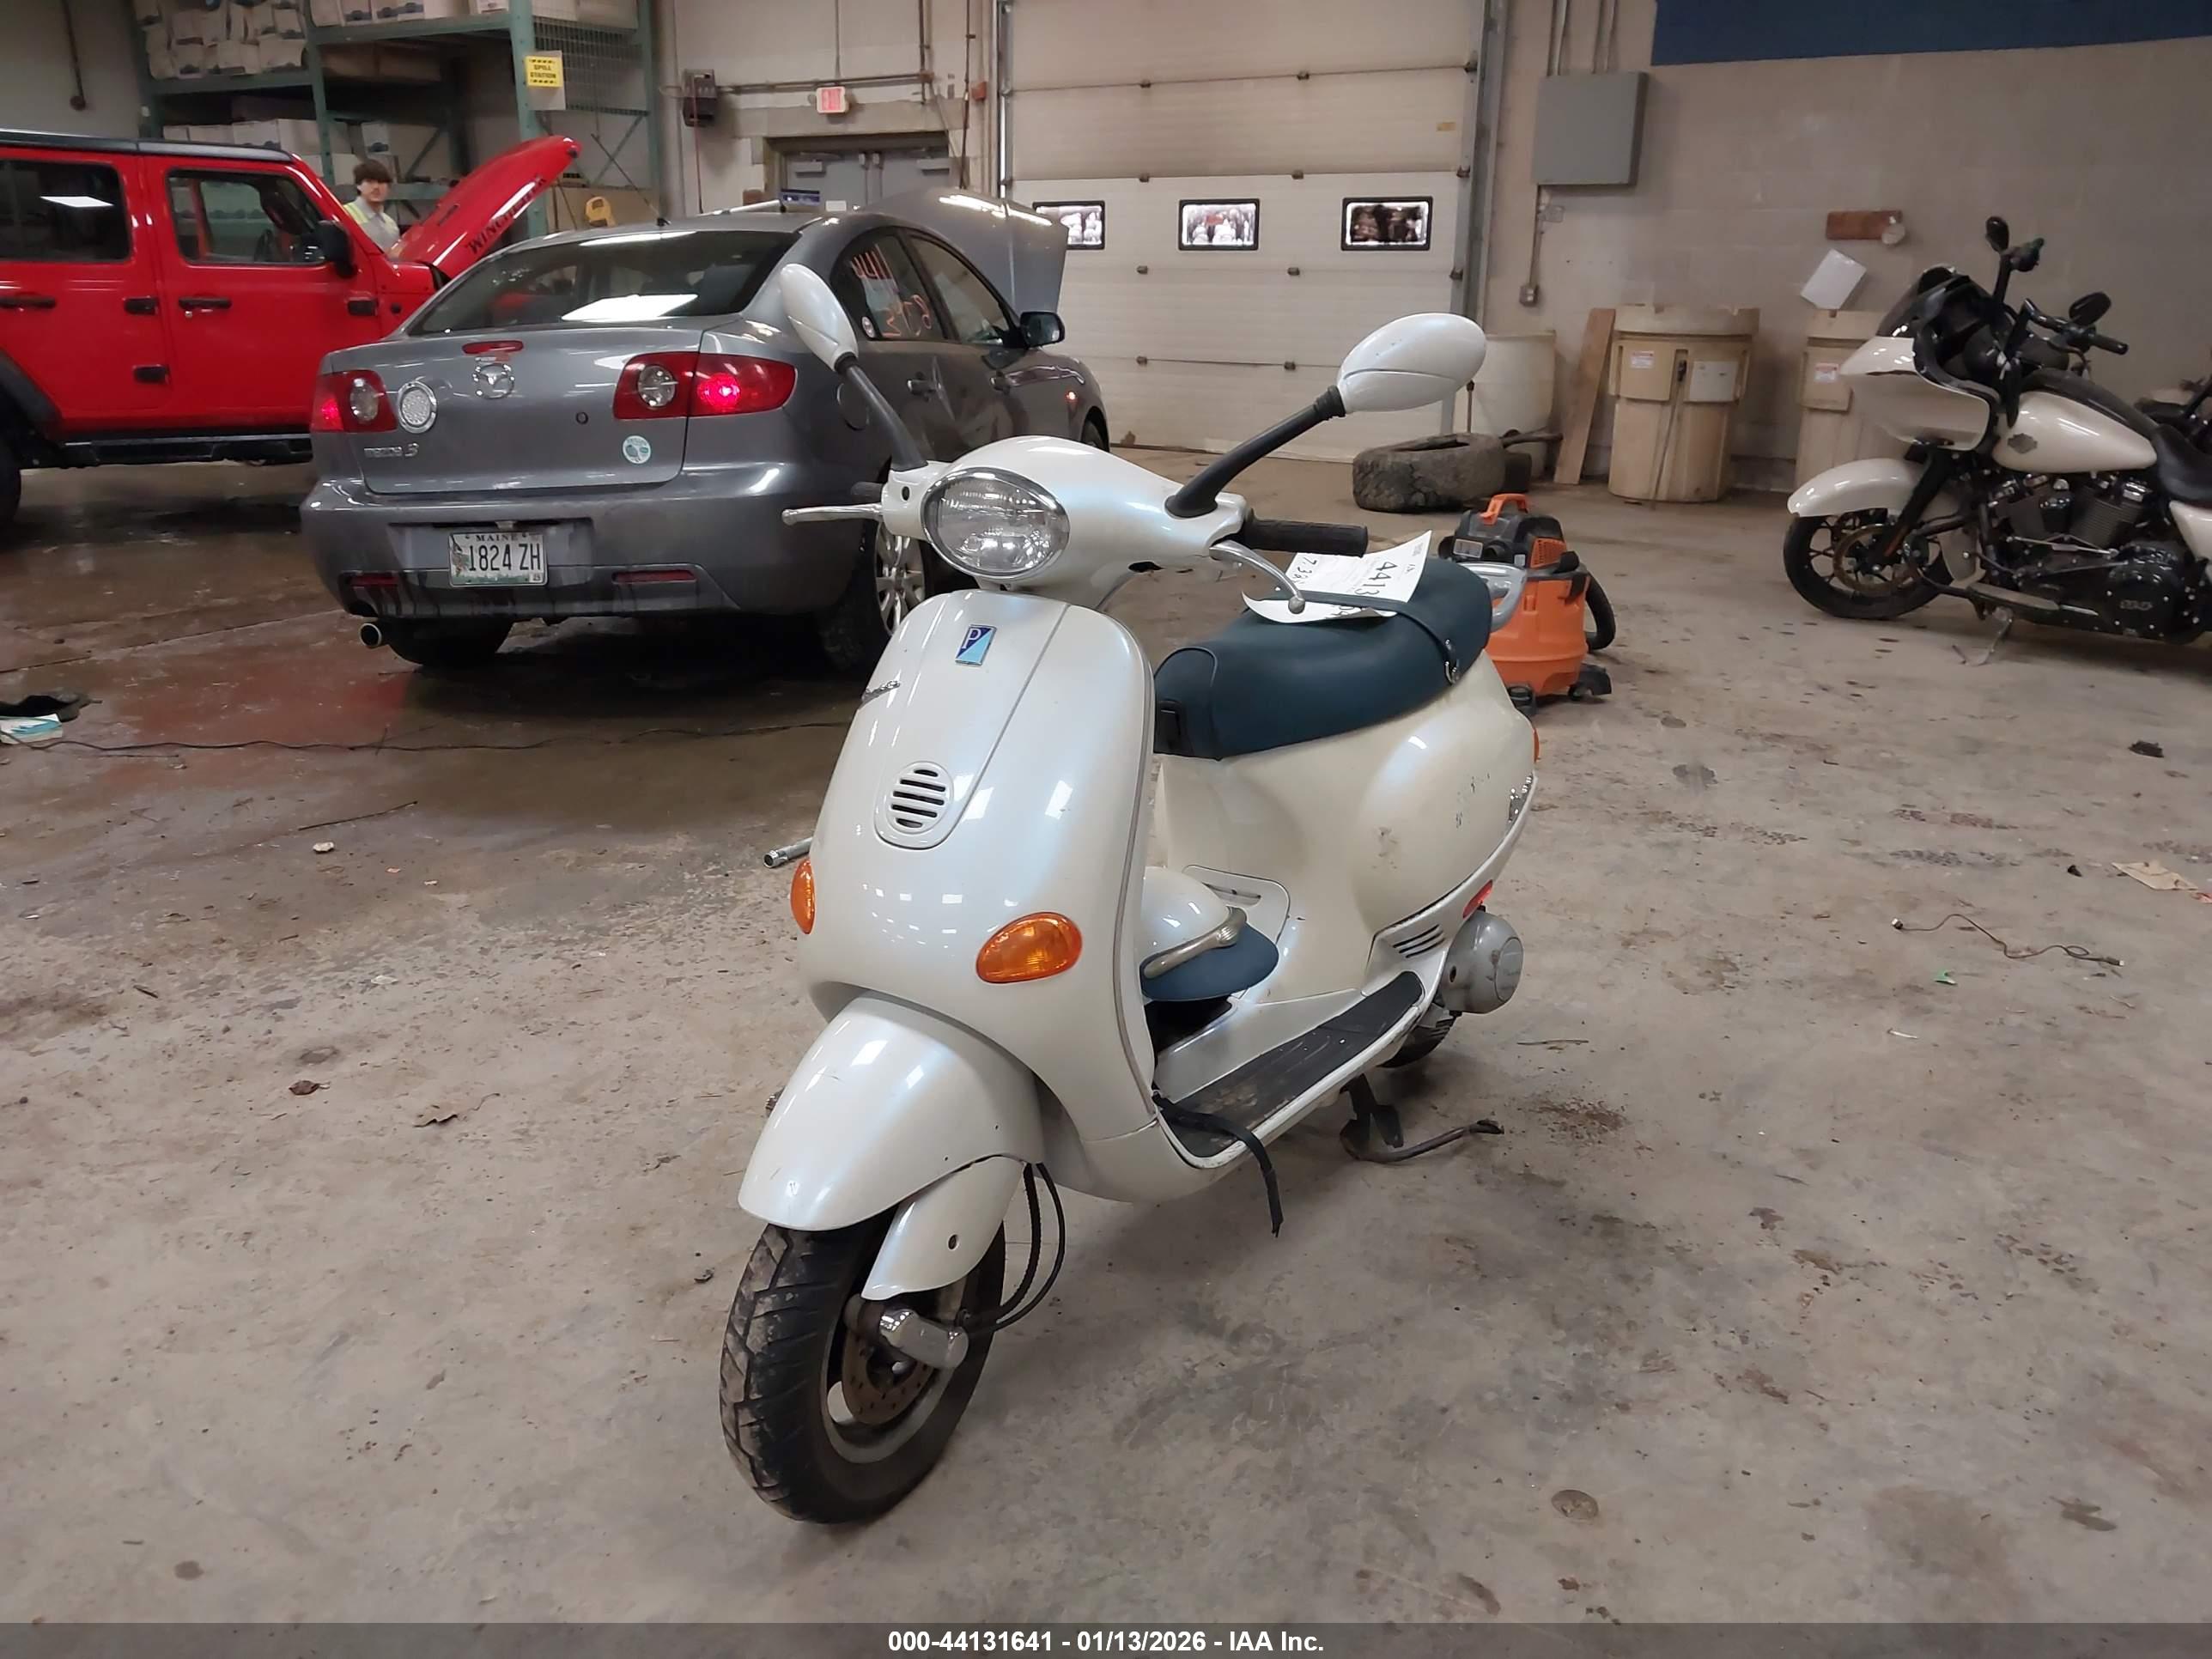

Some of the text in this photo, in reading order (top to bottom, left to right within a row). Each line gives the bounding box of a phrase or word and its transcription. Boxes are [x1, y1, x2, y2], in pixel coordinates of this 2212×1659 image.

[476, 533, 519, 542] MAINE
[469, 543, 541, 571] 1824 ZH
[961, 627, 981, 649] P
